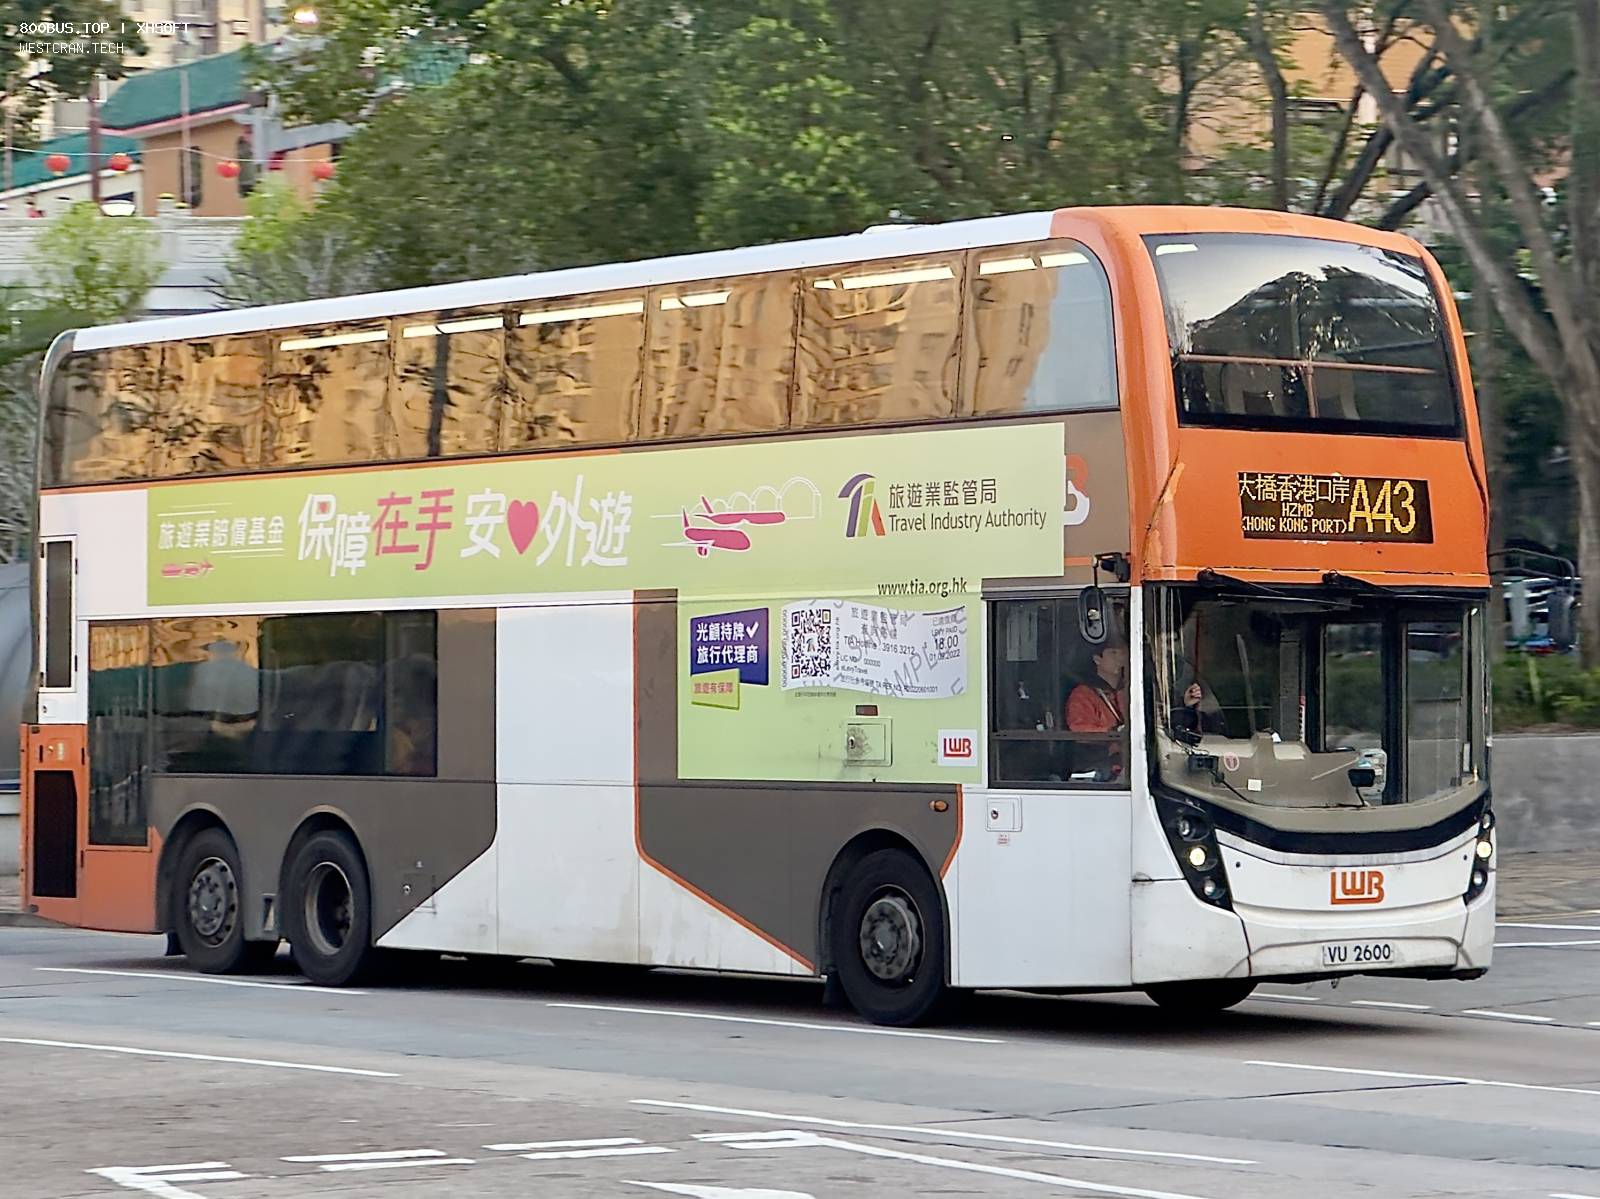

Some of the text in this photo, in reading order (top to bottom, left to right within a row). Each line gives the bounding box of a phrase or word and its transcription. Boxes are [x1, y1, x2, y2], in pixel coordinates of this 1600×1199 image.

[888, 478, 997, 509] 旅遊業監管局
[1238, 473, 1350, 504] 大橋香港口岸
[1281, 502, 1314, 518] HZMB
[1348, 479, 1416, 534] A43
[888, 507, 1047, 533] Travel Industry Authority
[1279, 518, 1308, 533] KONG
[1312, 518, 1348, 534] PORT)
[877, 577, 968, 597] www.tia.org.hk
[696, 622, 745, 641] 光顧持牌
[934, 634, 959, 650] 18.00
[696, 644, 759, 664] 旅行代理商
[943, 738, 972, 757] LWB
[1330, 871, 1385, 905] LWB
[1328, 944, 1392, 963] VU 2600
